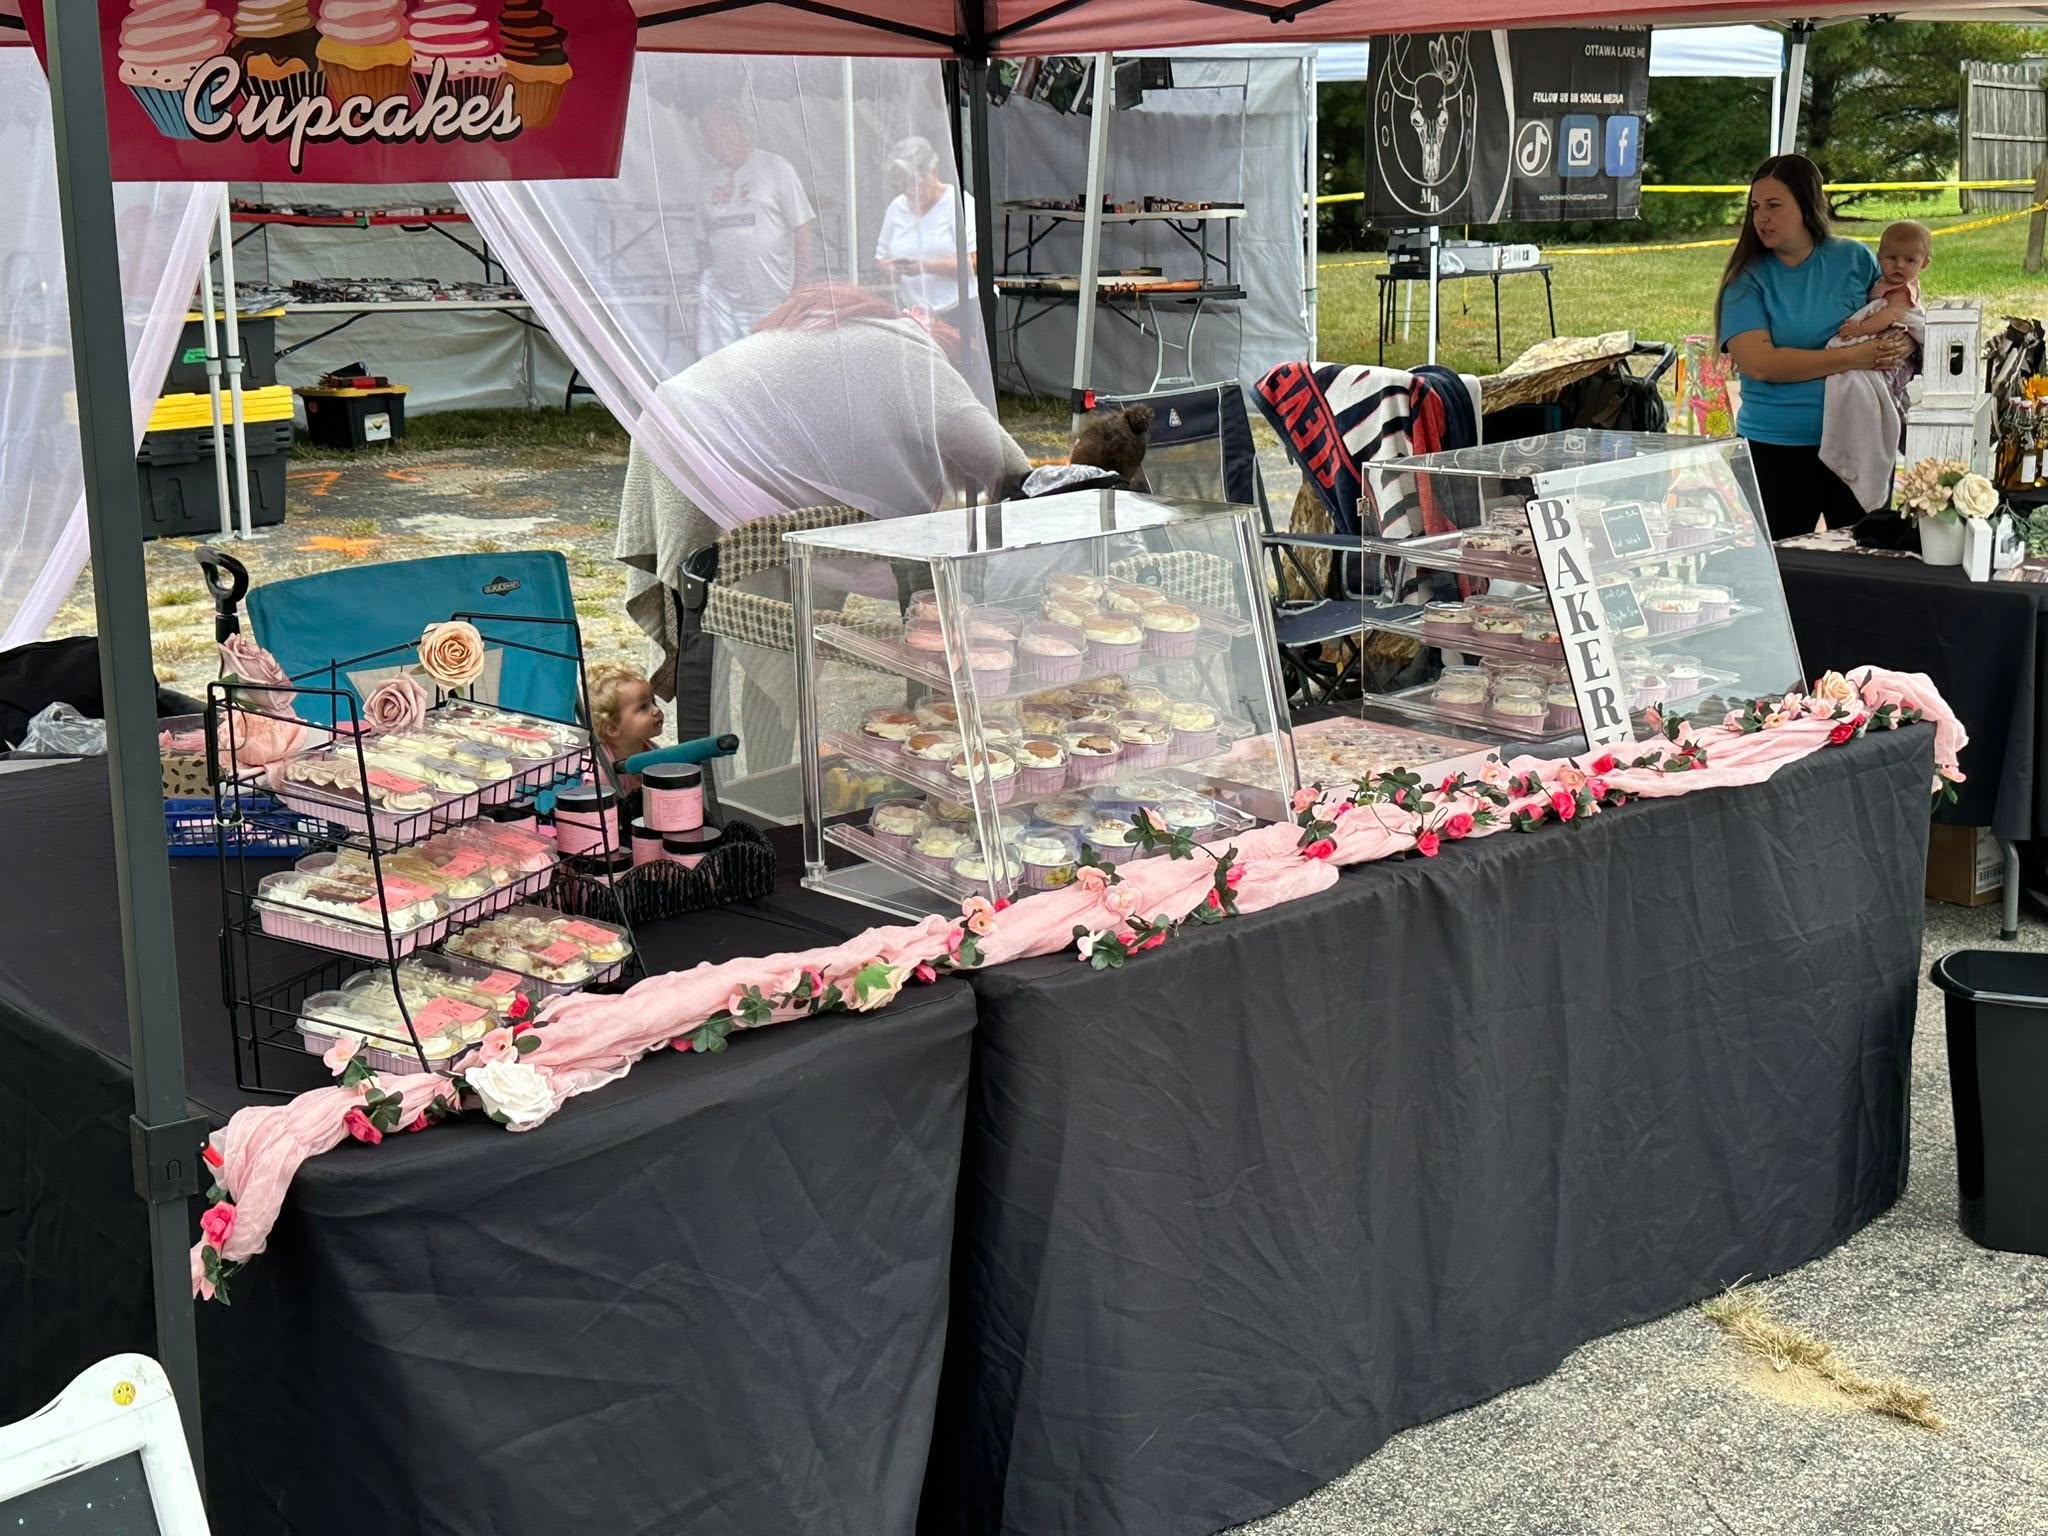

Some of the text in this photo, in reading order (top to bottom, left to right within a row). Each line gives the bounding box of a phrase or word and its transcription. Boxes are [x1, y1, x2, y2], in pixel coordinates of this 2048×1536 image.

[1584, 44, 1616, 56] OTTAWA
[1617, 46, 1636, 58] LAKE
[1532, 91, 1624, 105] FOLLOW US ON SOCIAL MEDIA
[183, 54, 522, 170] Cupcakes
